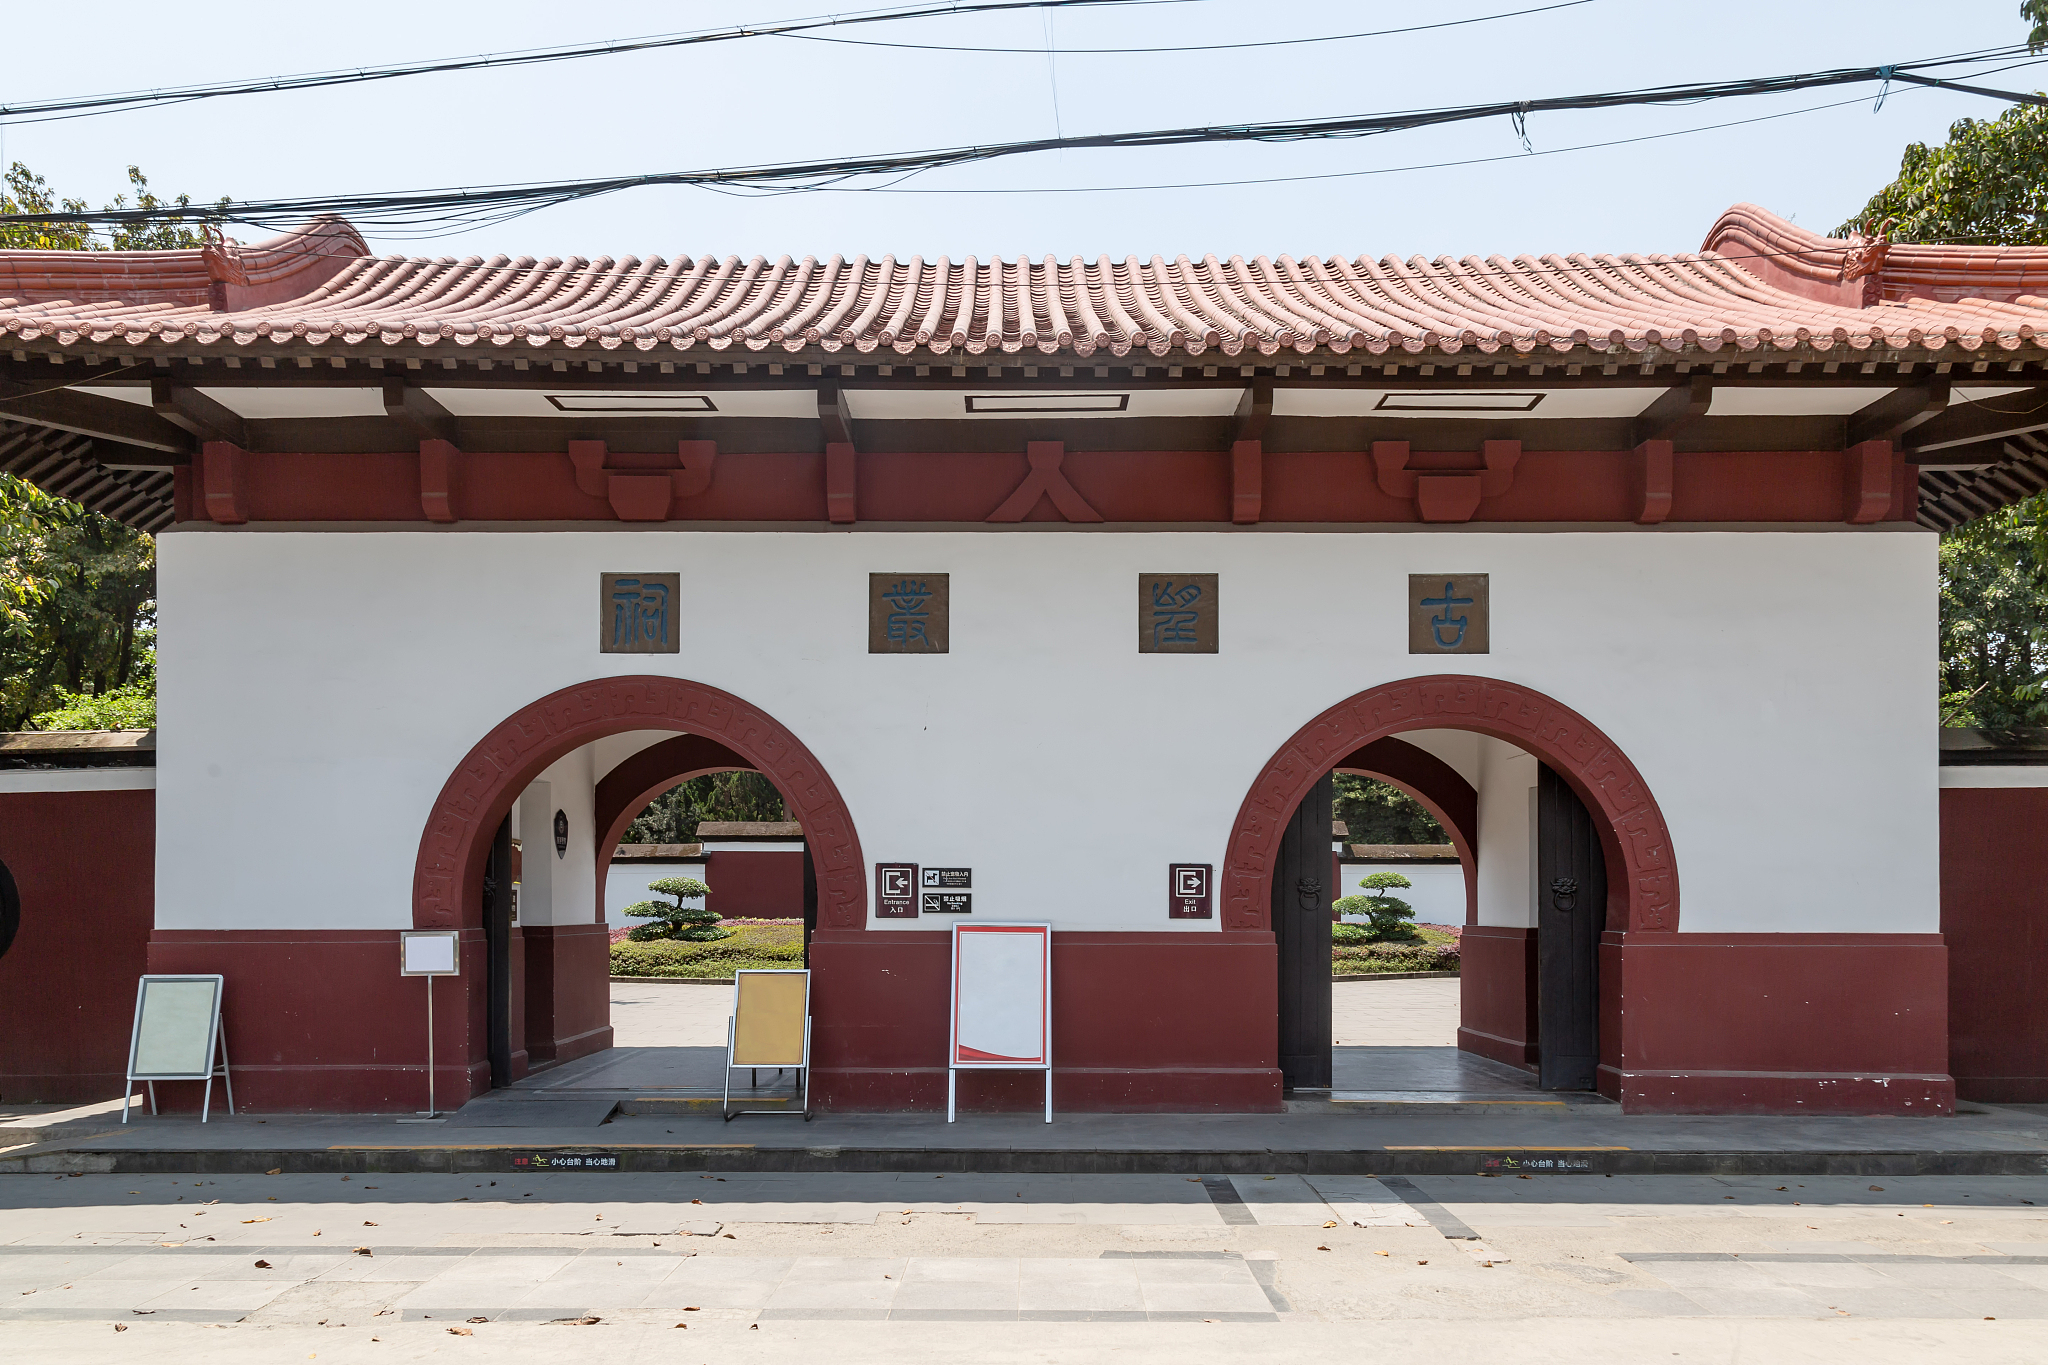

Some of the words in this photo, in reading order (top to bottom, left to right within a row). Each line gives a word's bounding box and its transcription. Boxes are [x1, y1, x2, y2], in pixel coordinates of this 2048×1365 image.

[889, 906, 904, 914] 入口
[551, 1157, 582, 1166] 小心台阶
[585, 1157, 616, 1166] 当心地滑
